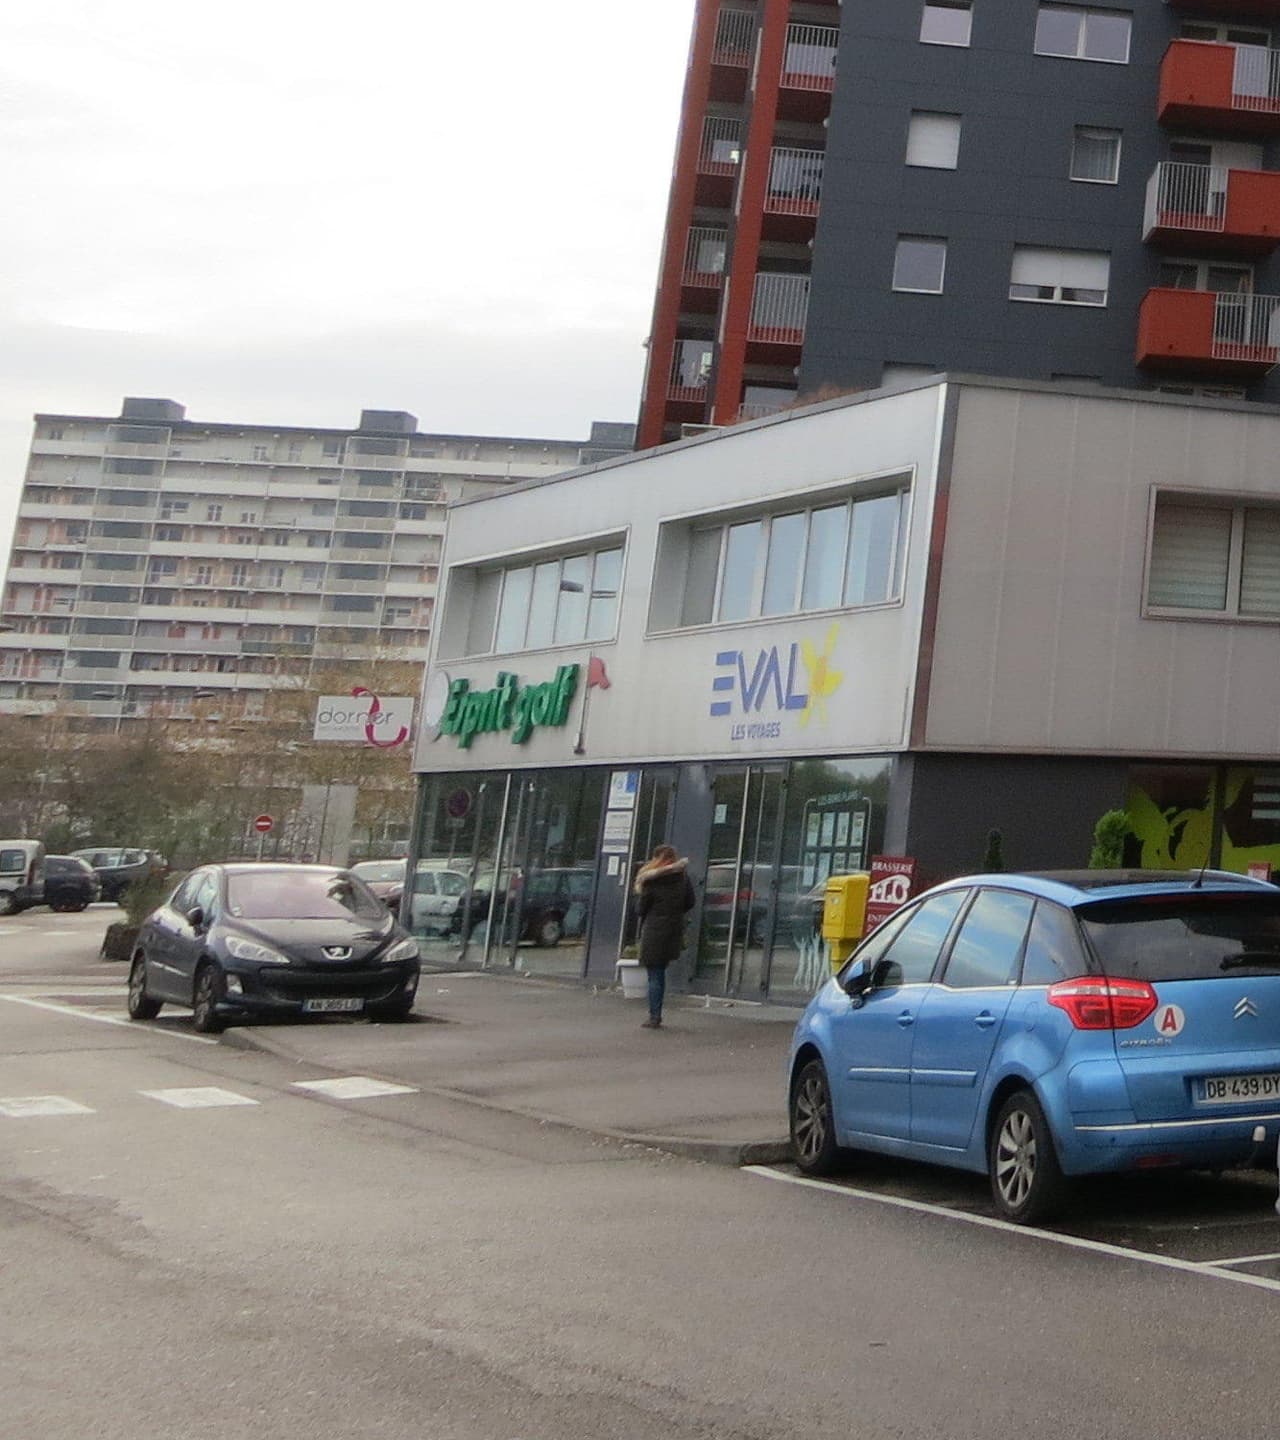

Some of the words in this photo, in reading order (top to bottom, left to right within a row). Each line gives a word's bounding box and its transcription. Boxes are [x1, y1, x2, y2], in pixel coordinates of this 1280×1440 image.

[511, 663, 580, 745] golf
[710, 643, 808, 717] EVAL
[871, 861, 913, 874] BRASSERIE
[1161, 1007, 1178, 1032] A
